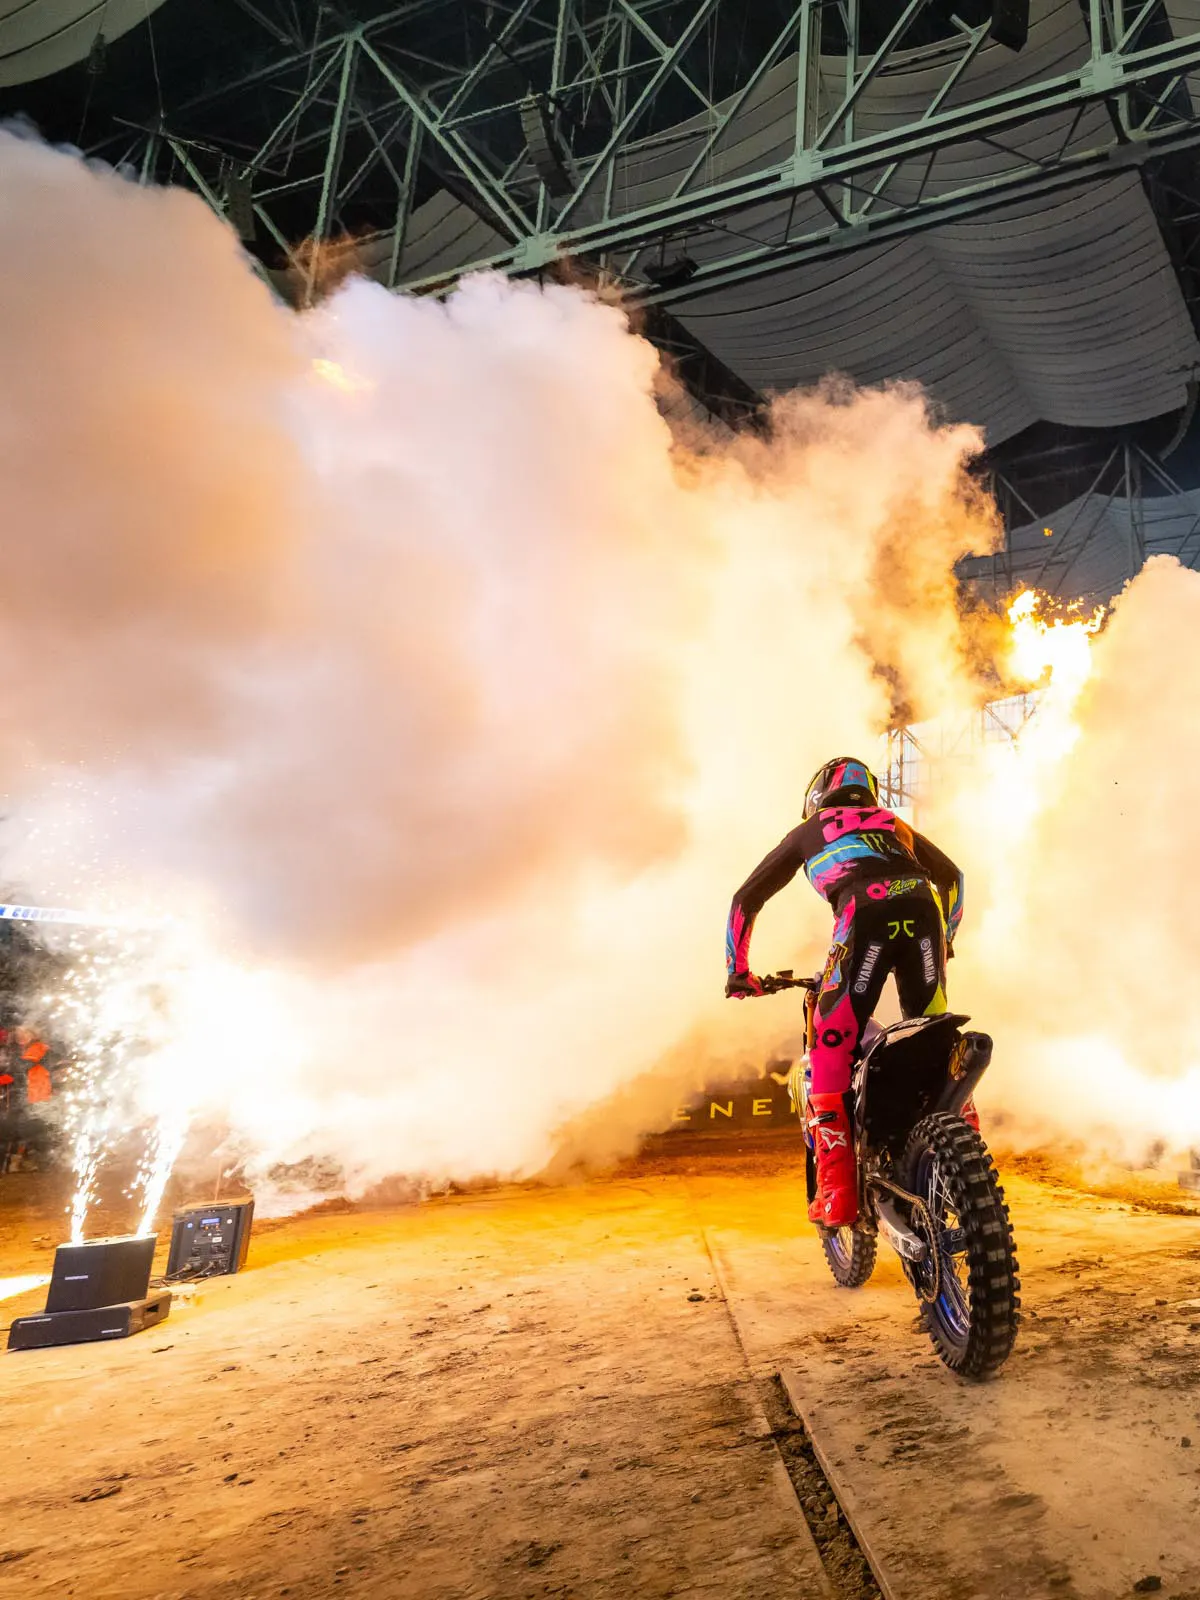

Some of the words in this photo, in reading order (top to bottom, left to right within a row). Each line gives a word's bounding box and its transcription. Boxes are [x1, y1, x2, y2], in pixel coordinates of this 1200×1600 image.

[819, 806, 896, 843] 32
[857, 945, 881, 982] YAMAHA
[923, 947, 936, 984] YAMAHA
